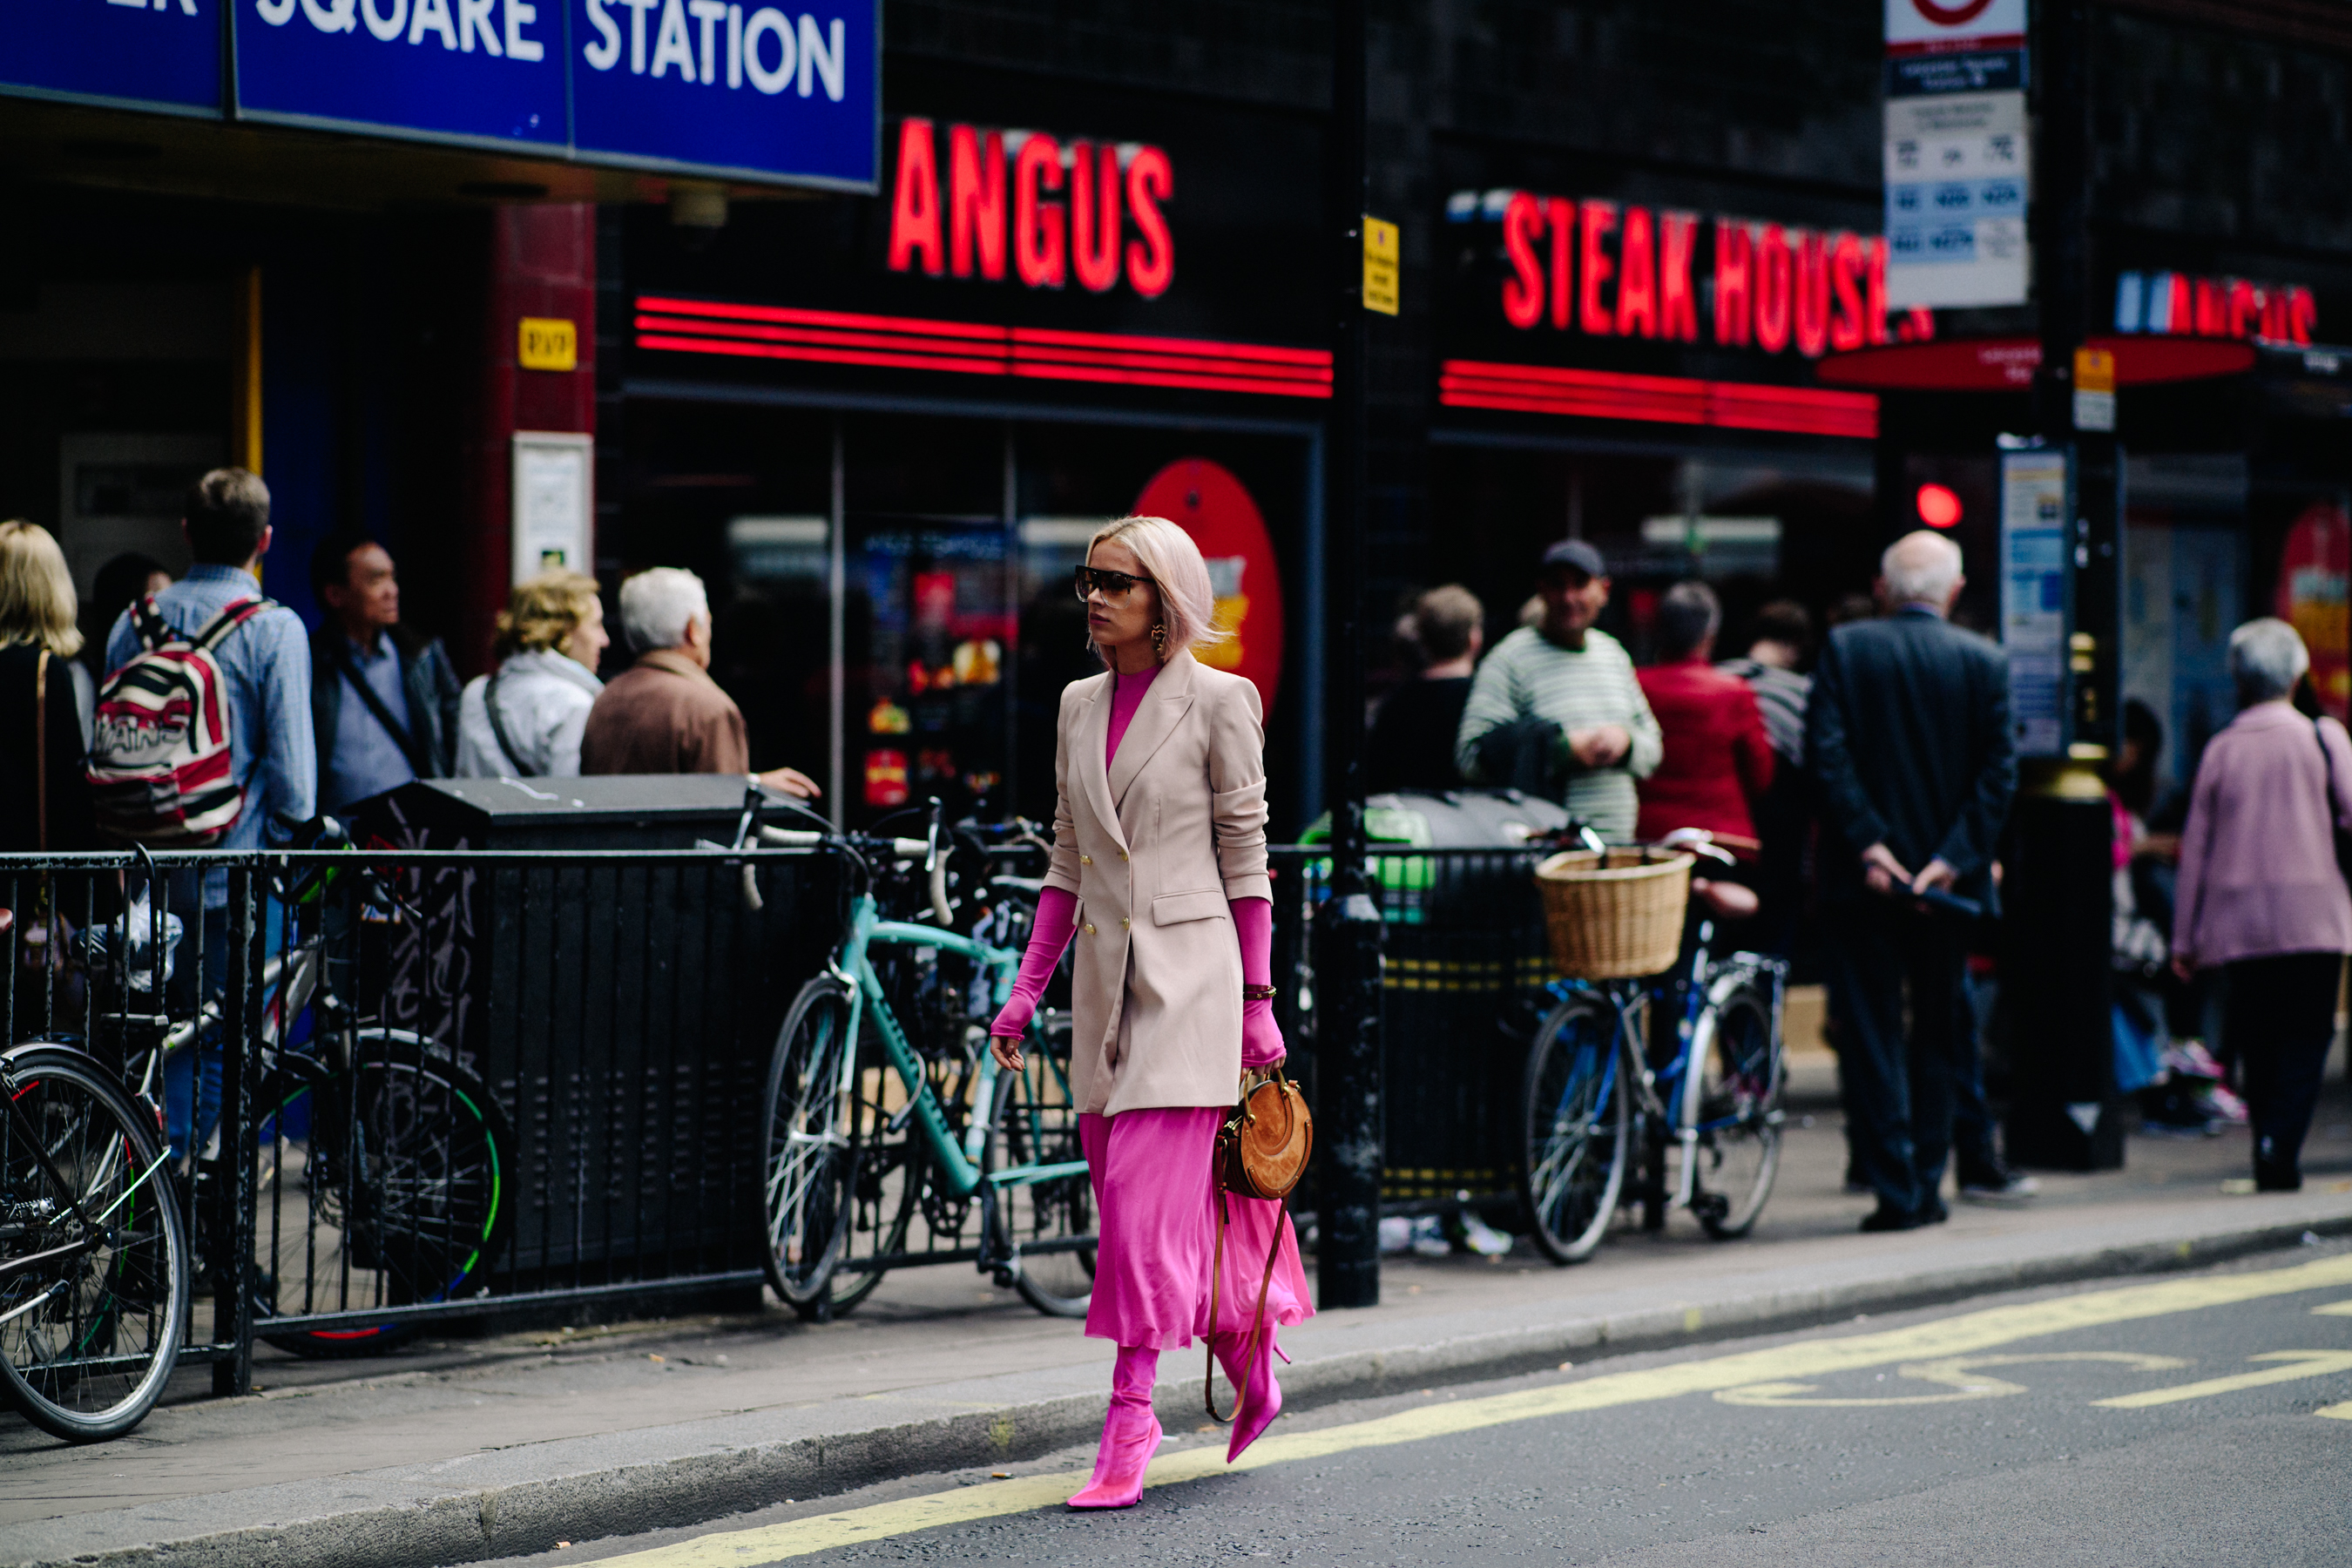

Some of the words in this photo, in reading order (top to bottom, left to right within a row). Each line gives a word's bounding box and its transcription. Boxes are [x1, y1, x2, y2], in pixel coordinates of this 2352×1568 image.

[255, 0, 544, 62] UARE
[583, 0, 845, 103] STATION
[887, 116, 1174, 299] ANGUS
[1502, 189, 1700, 344] STEAK
